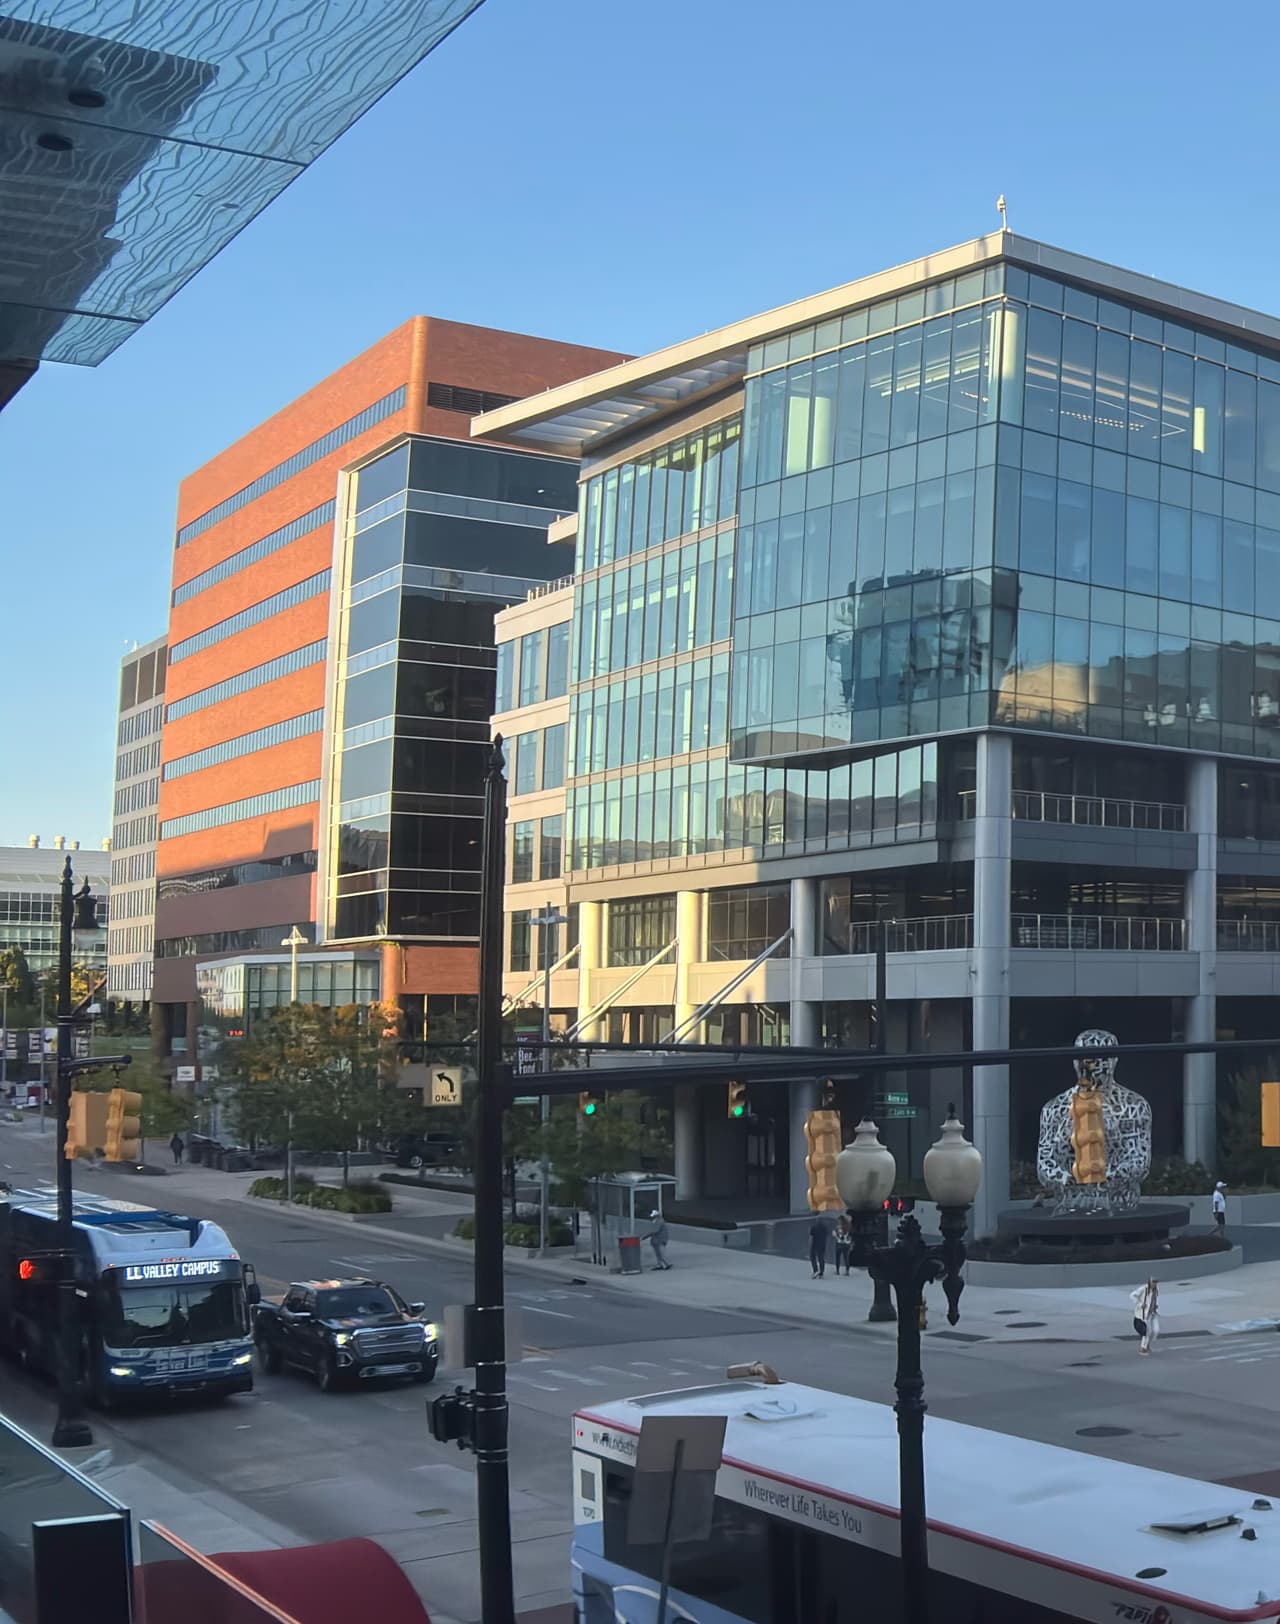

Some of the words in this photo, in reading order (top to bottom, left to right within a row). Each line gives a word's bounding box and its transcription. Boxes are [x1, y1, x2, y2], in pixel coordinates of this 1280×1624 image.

[435, 1094, 457, 1103] ONLY
[143, 1264, 180, 1279] VALLEY
[181, 1261, 220, 1276] CAMPUS
[744, 1480, 790, 1510] Wherever
[792, 1494, 809, 1516] Life
[811, 1500, 839, 1527] Takes
[841, 1509, 863, 1534] You
